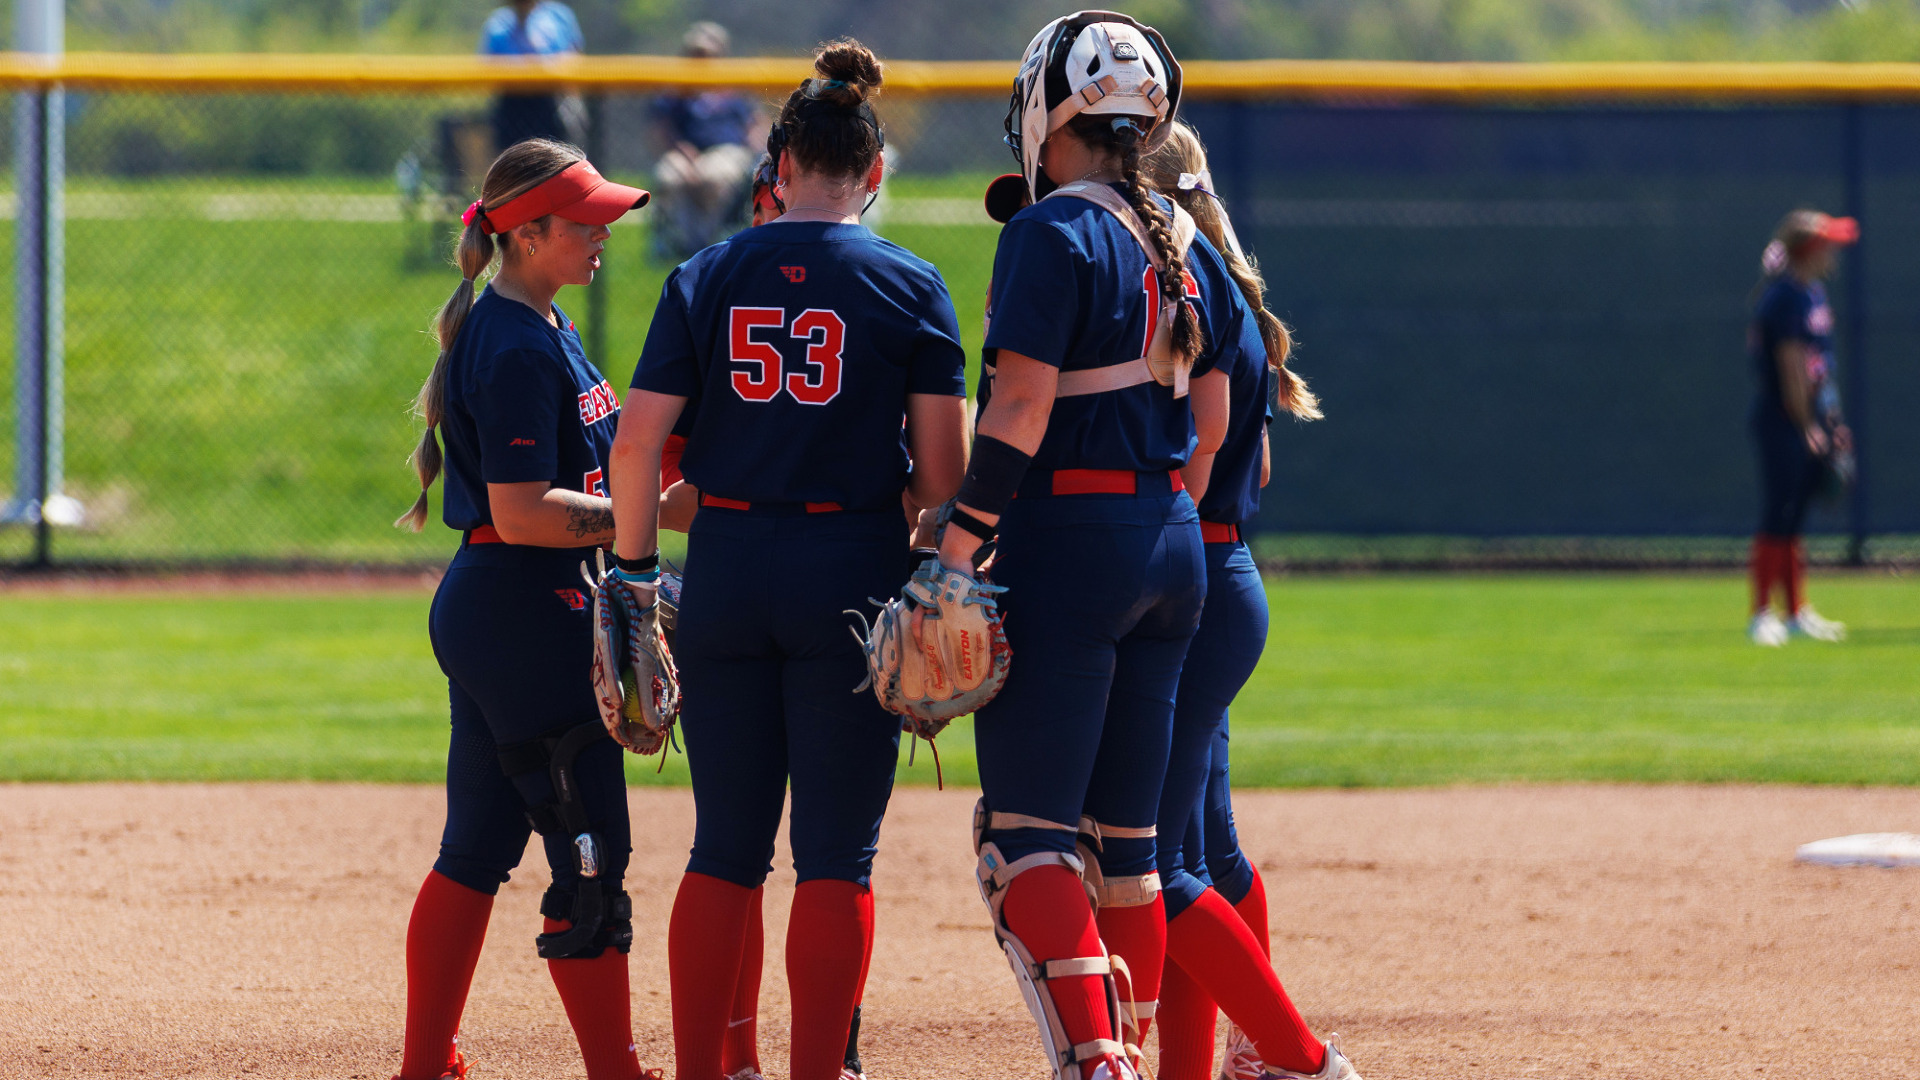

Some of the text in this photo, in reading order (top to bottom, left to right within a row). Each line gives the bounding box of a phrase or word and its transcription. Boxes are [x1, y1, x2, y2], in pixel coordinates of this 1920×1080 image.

[730, 307, 846, 406] 53
[1141, 264, 1200, 358] 1
[960, 629, 973, 680] EASTON
